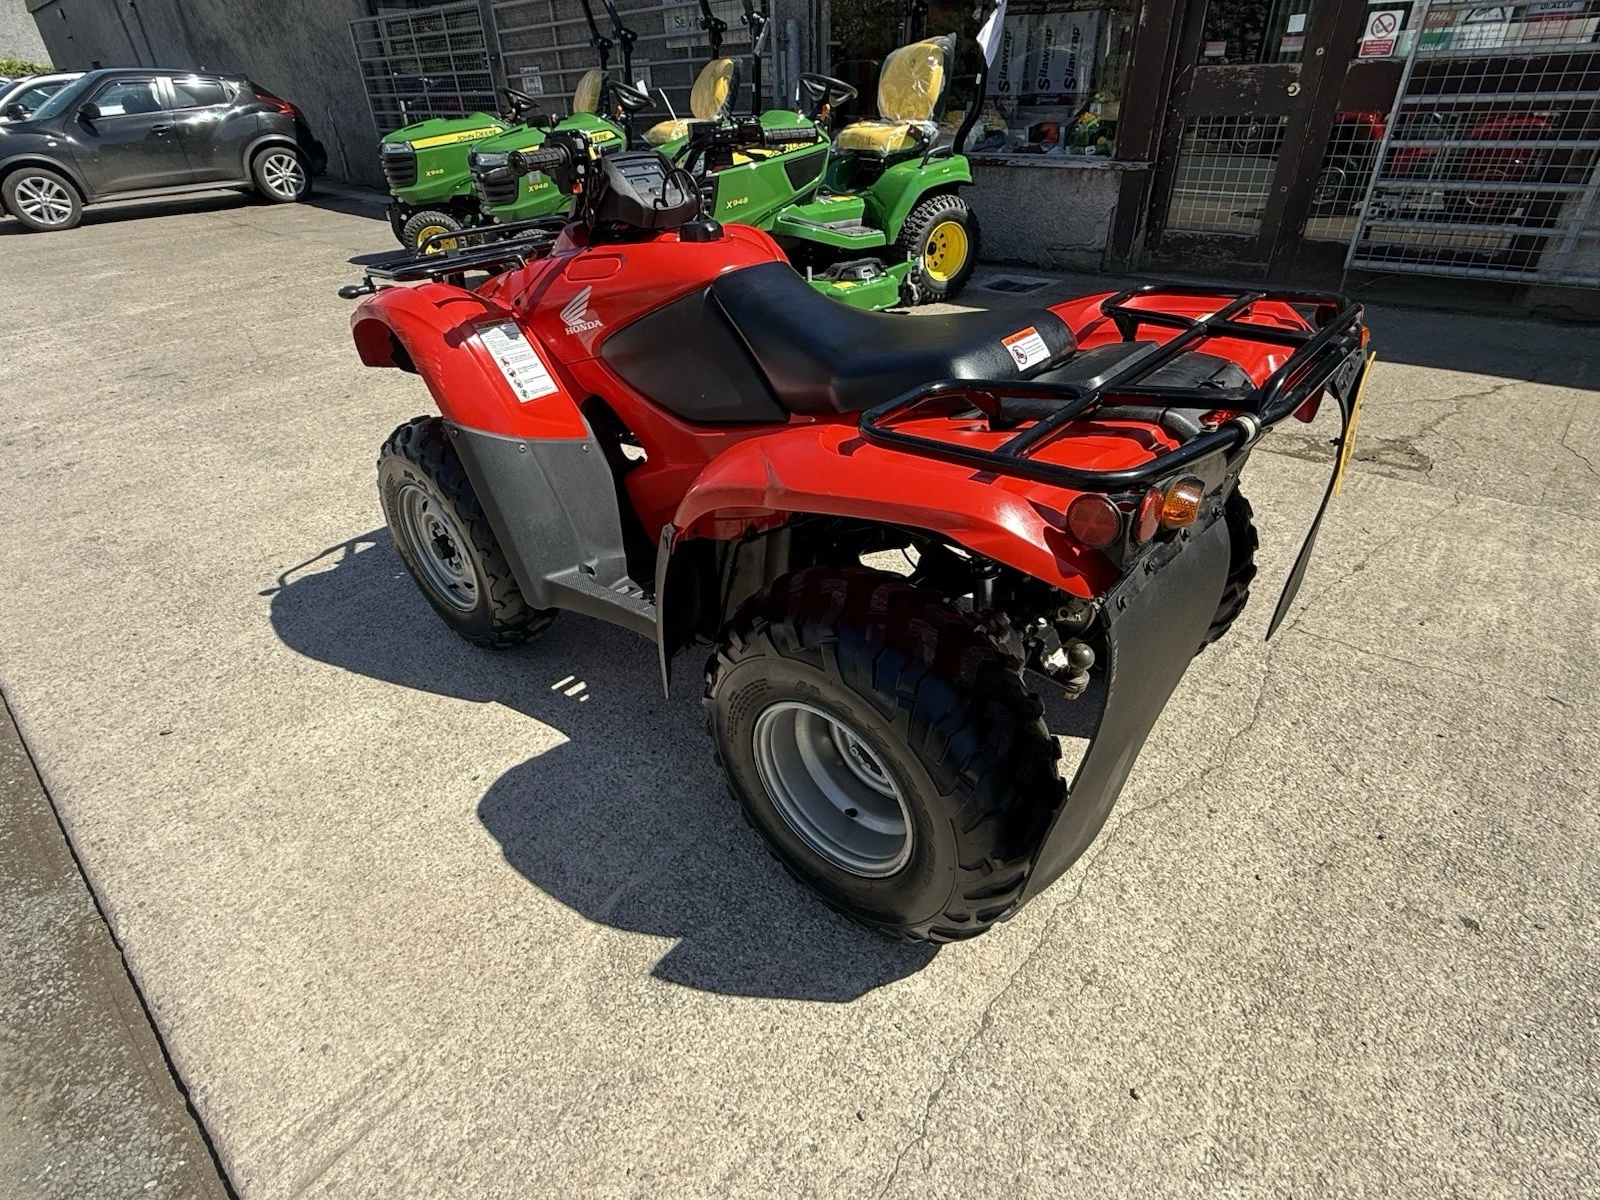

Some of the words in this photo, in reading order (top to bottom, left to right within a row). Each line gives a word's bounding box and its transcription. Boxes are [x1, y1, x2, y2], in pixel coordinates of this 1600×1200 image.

[998, 31, 1012, 92] Silawrap
[1038, 27, 1052, 91] Silawrap
[1064, 26, 1080, 91] Silawrap
[457, 134, 474, 142] JOHN
[475, 128, 497, 138] DEERE
[425, 168, 444, 176] X948
[528, 182, 549, 193] X948
[725, 197, 749, 210] X948
[565, 320, 603, 335] HONDA
